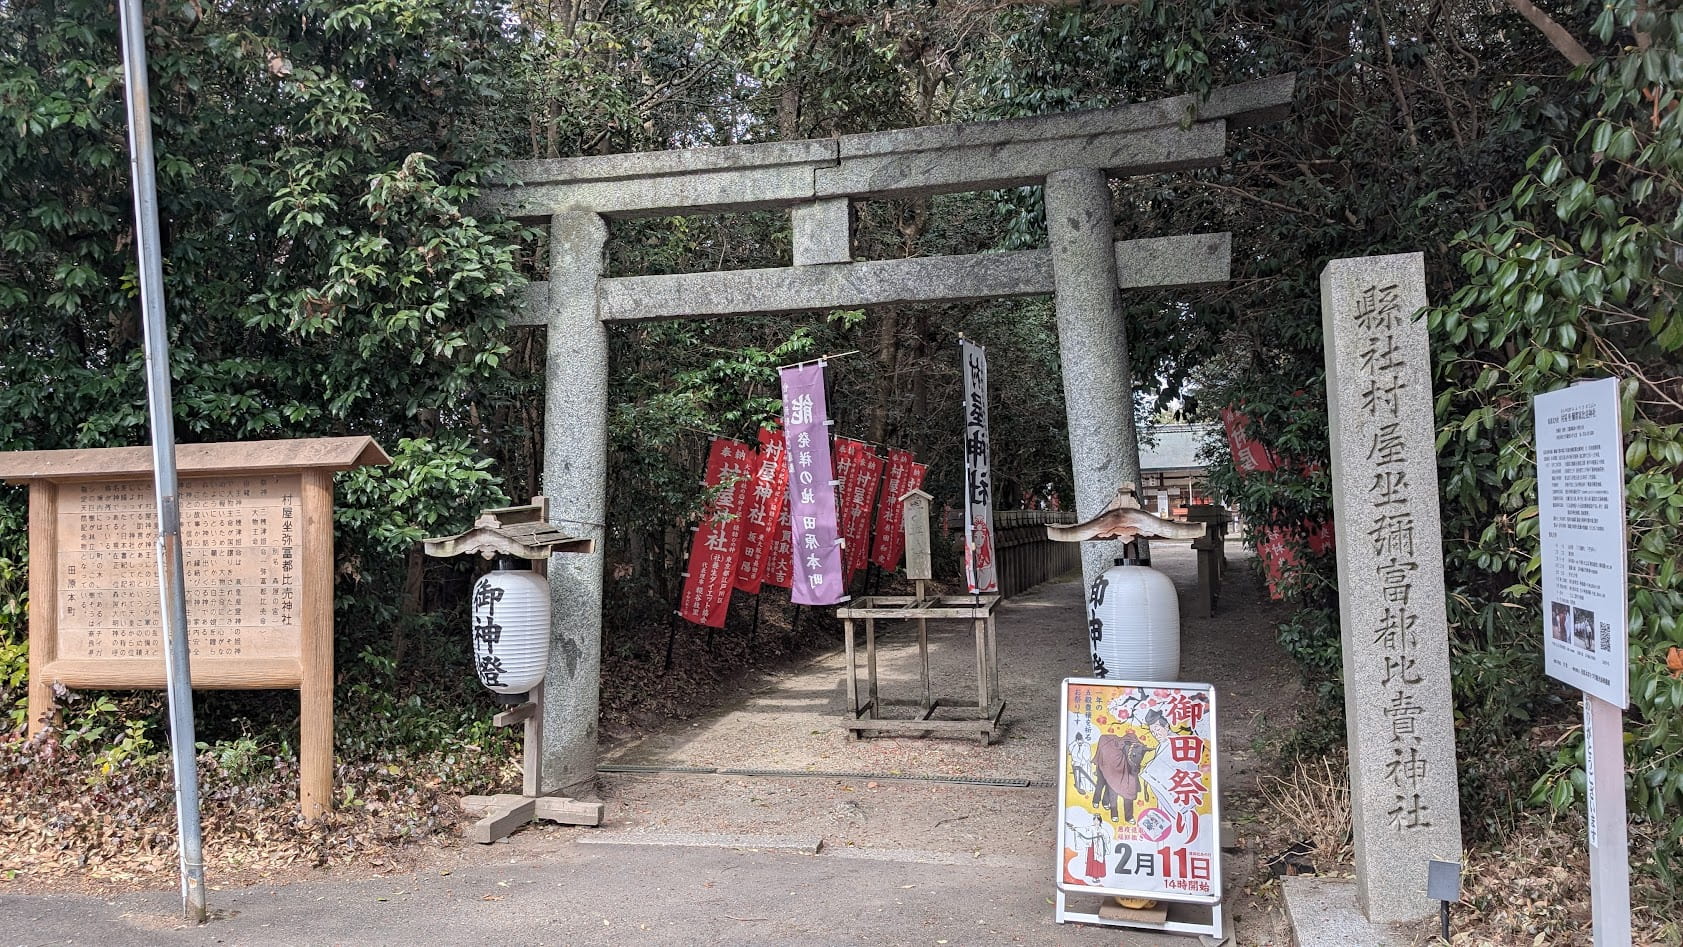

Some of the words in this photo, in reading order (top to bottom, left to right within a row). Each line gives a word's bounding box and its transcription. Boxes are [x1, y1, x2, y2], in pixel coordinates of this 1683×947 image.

[721, 446, 746, 461] 奉納
[744, 439, 784, 526] 村屋神社
[67, 565, 76, 617] 田原本町
[1074, 689, 1082, 725] お祭りです
[1095, 691, 1103, 712] 一年の
[1166, 695, 1208, 845] 御田祭り
[1164, 880, 1210, 892] 14時開始
